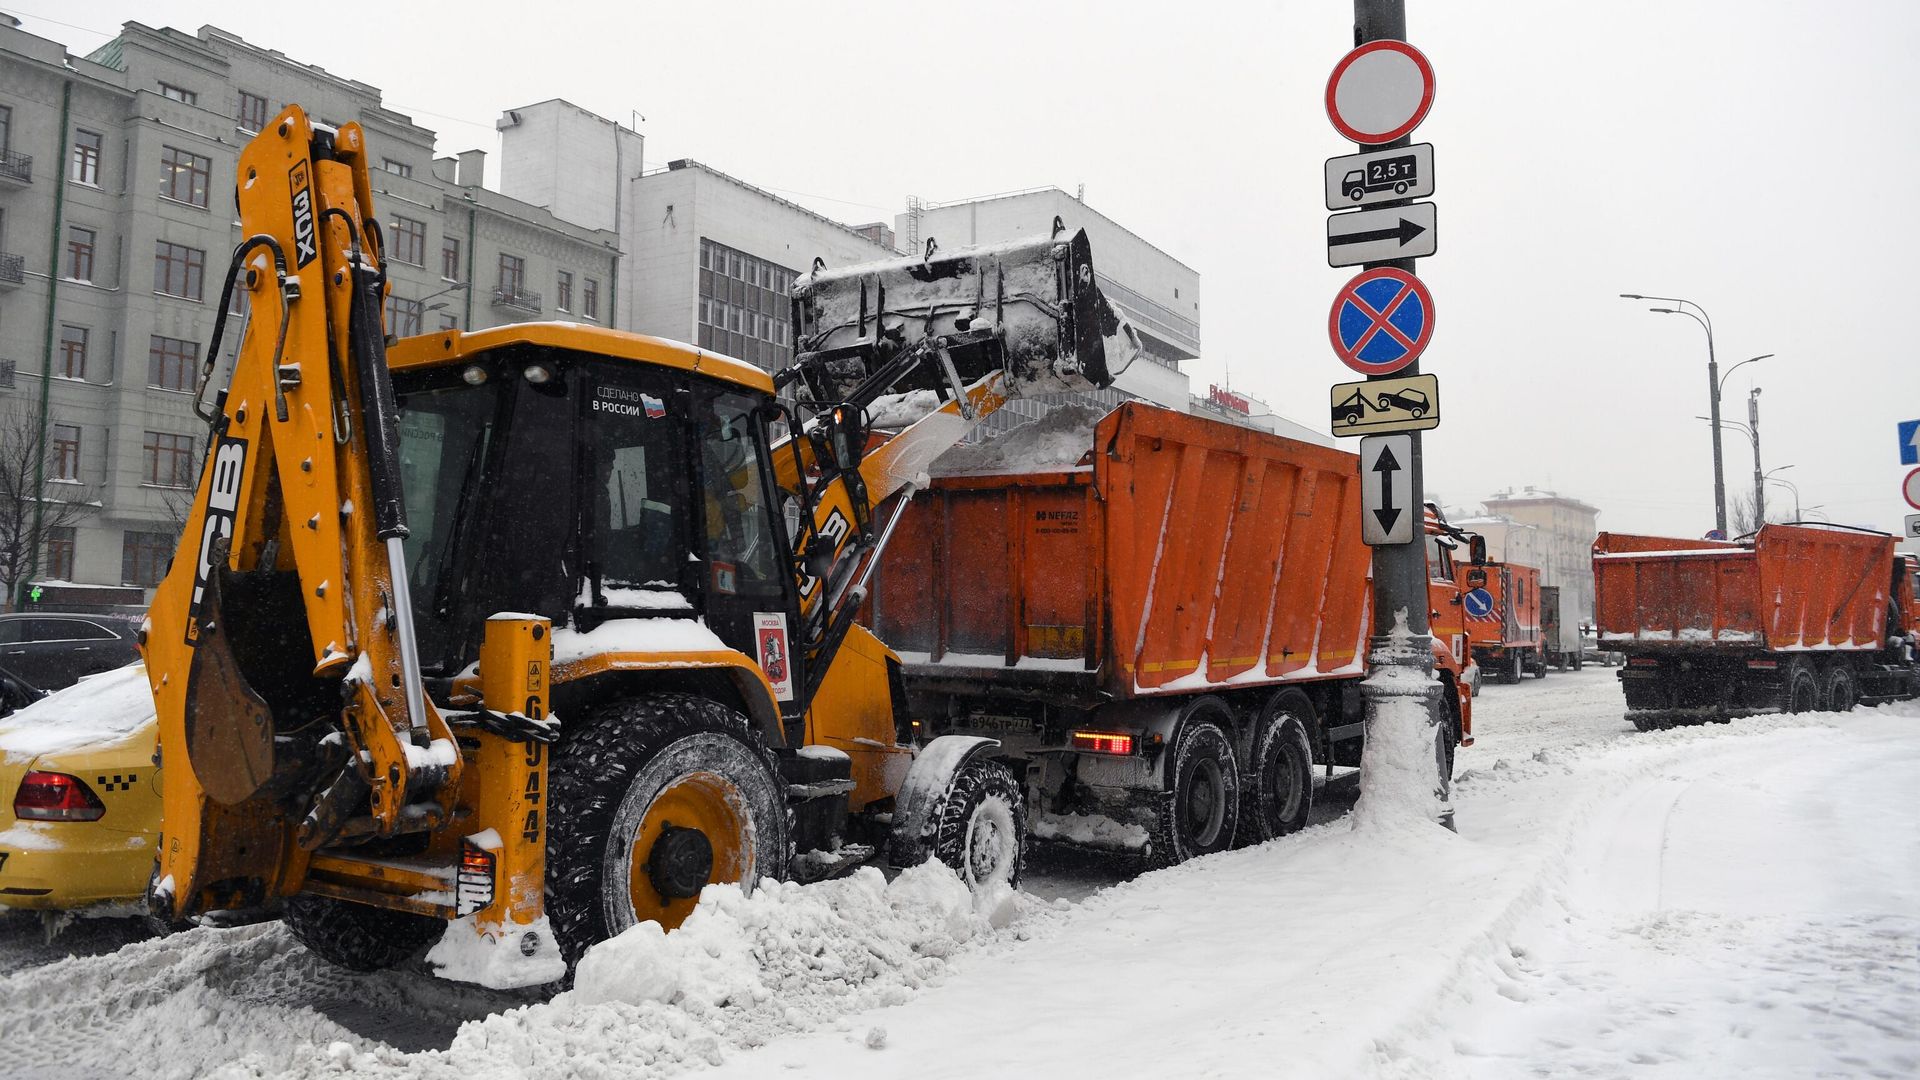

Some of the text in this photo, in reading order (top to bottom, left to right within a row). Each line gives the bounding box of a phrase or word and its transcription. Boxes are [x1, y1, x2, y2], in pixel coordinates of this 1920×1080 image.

[1373, 163, 1397, 180] 2,5
[294, 190, 315, 264] 3CX
[597, 386, 639, 402] СДЕЛАНО
[592, 400, 639, 416] В РОССИИ
[761, 619, 780, 627] МОСКВА
